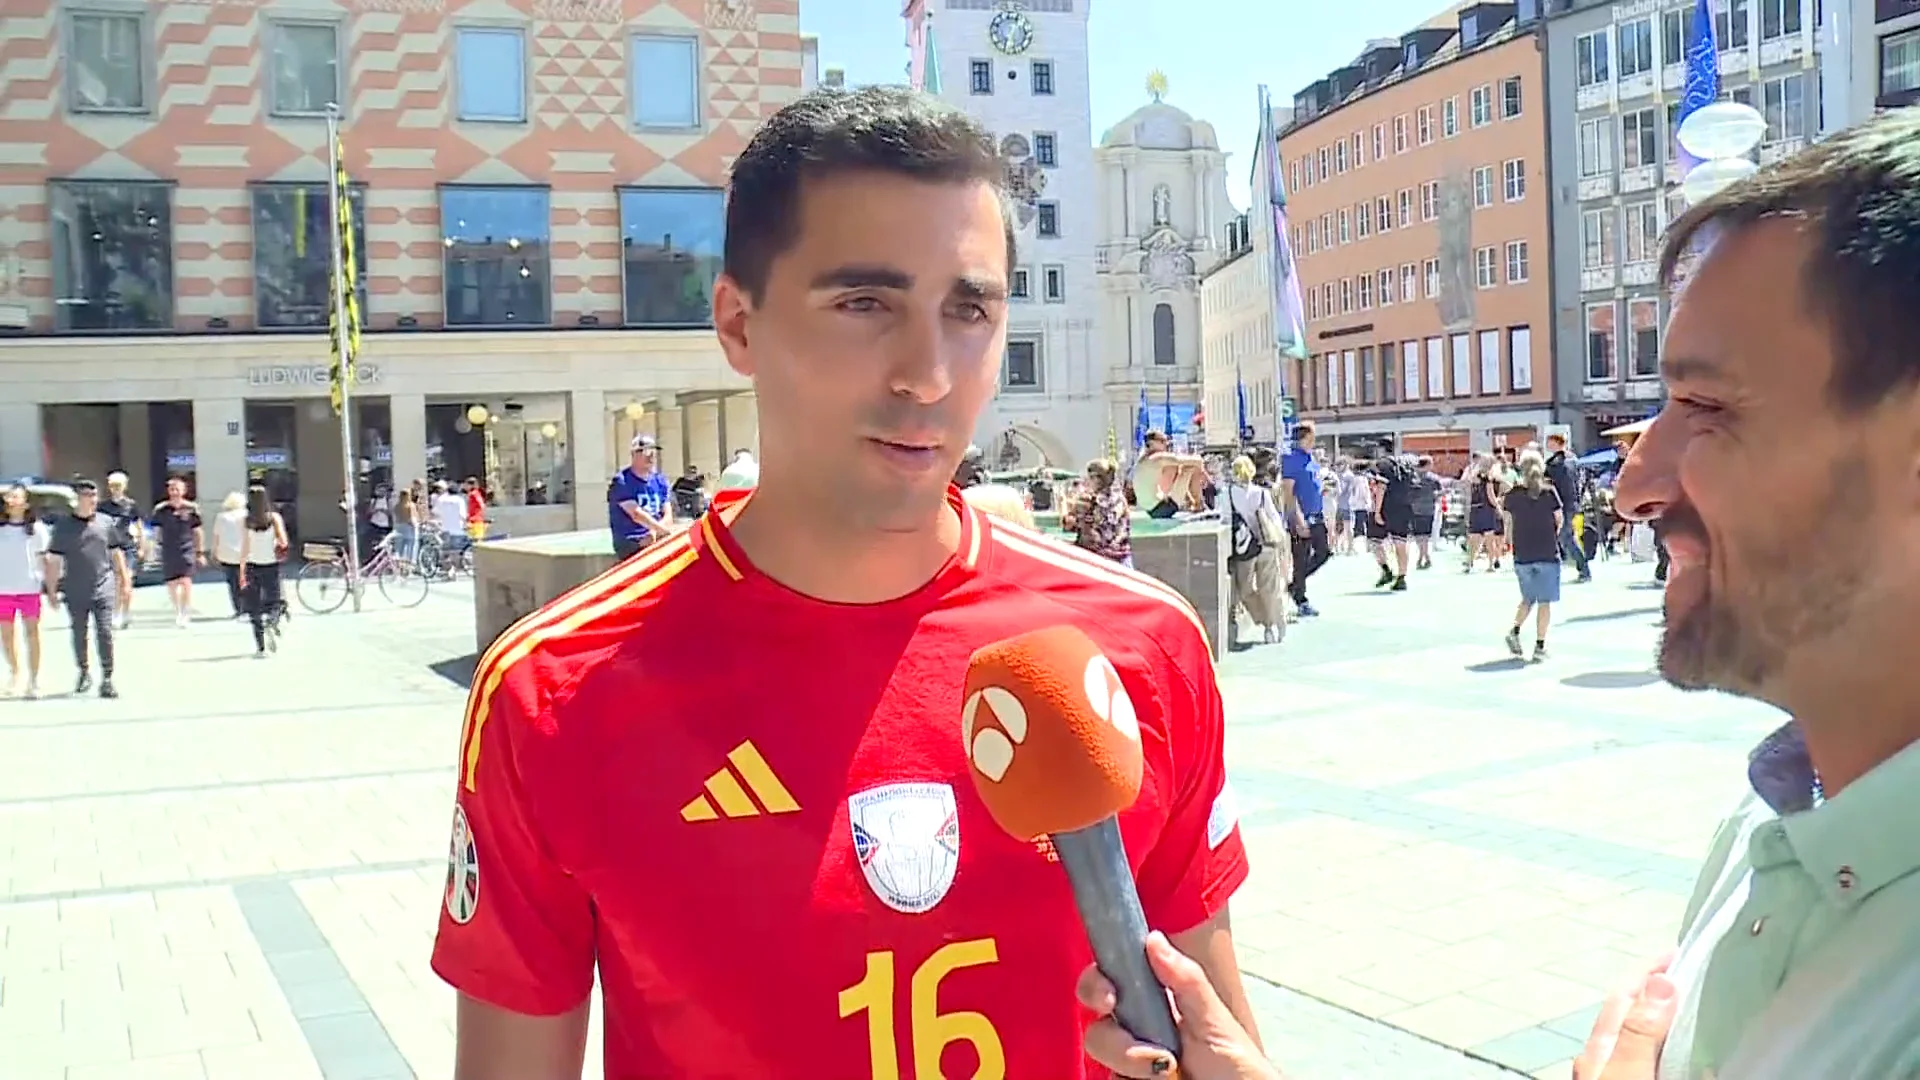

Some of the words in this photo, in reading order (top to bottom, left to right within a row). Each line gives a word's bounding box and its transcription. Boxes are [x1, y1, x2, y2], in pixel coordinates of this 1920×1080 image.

[248, 366, 330, 386] LUDWIG
[1281, 400, 1293, 418] S
[838, 937, 1006, 1080] 16
